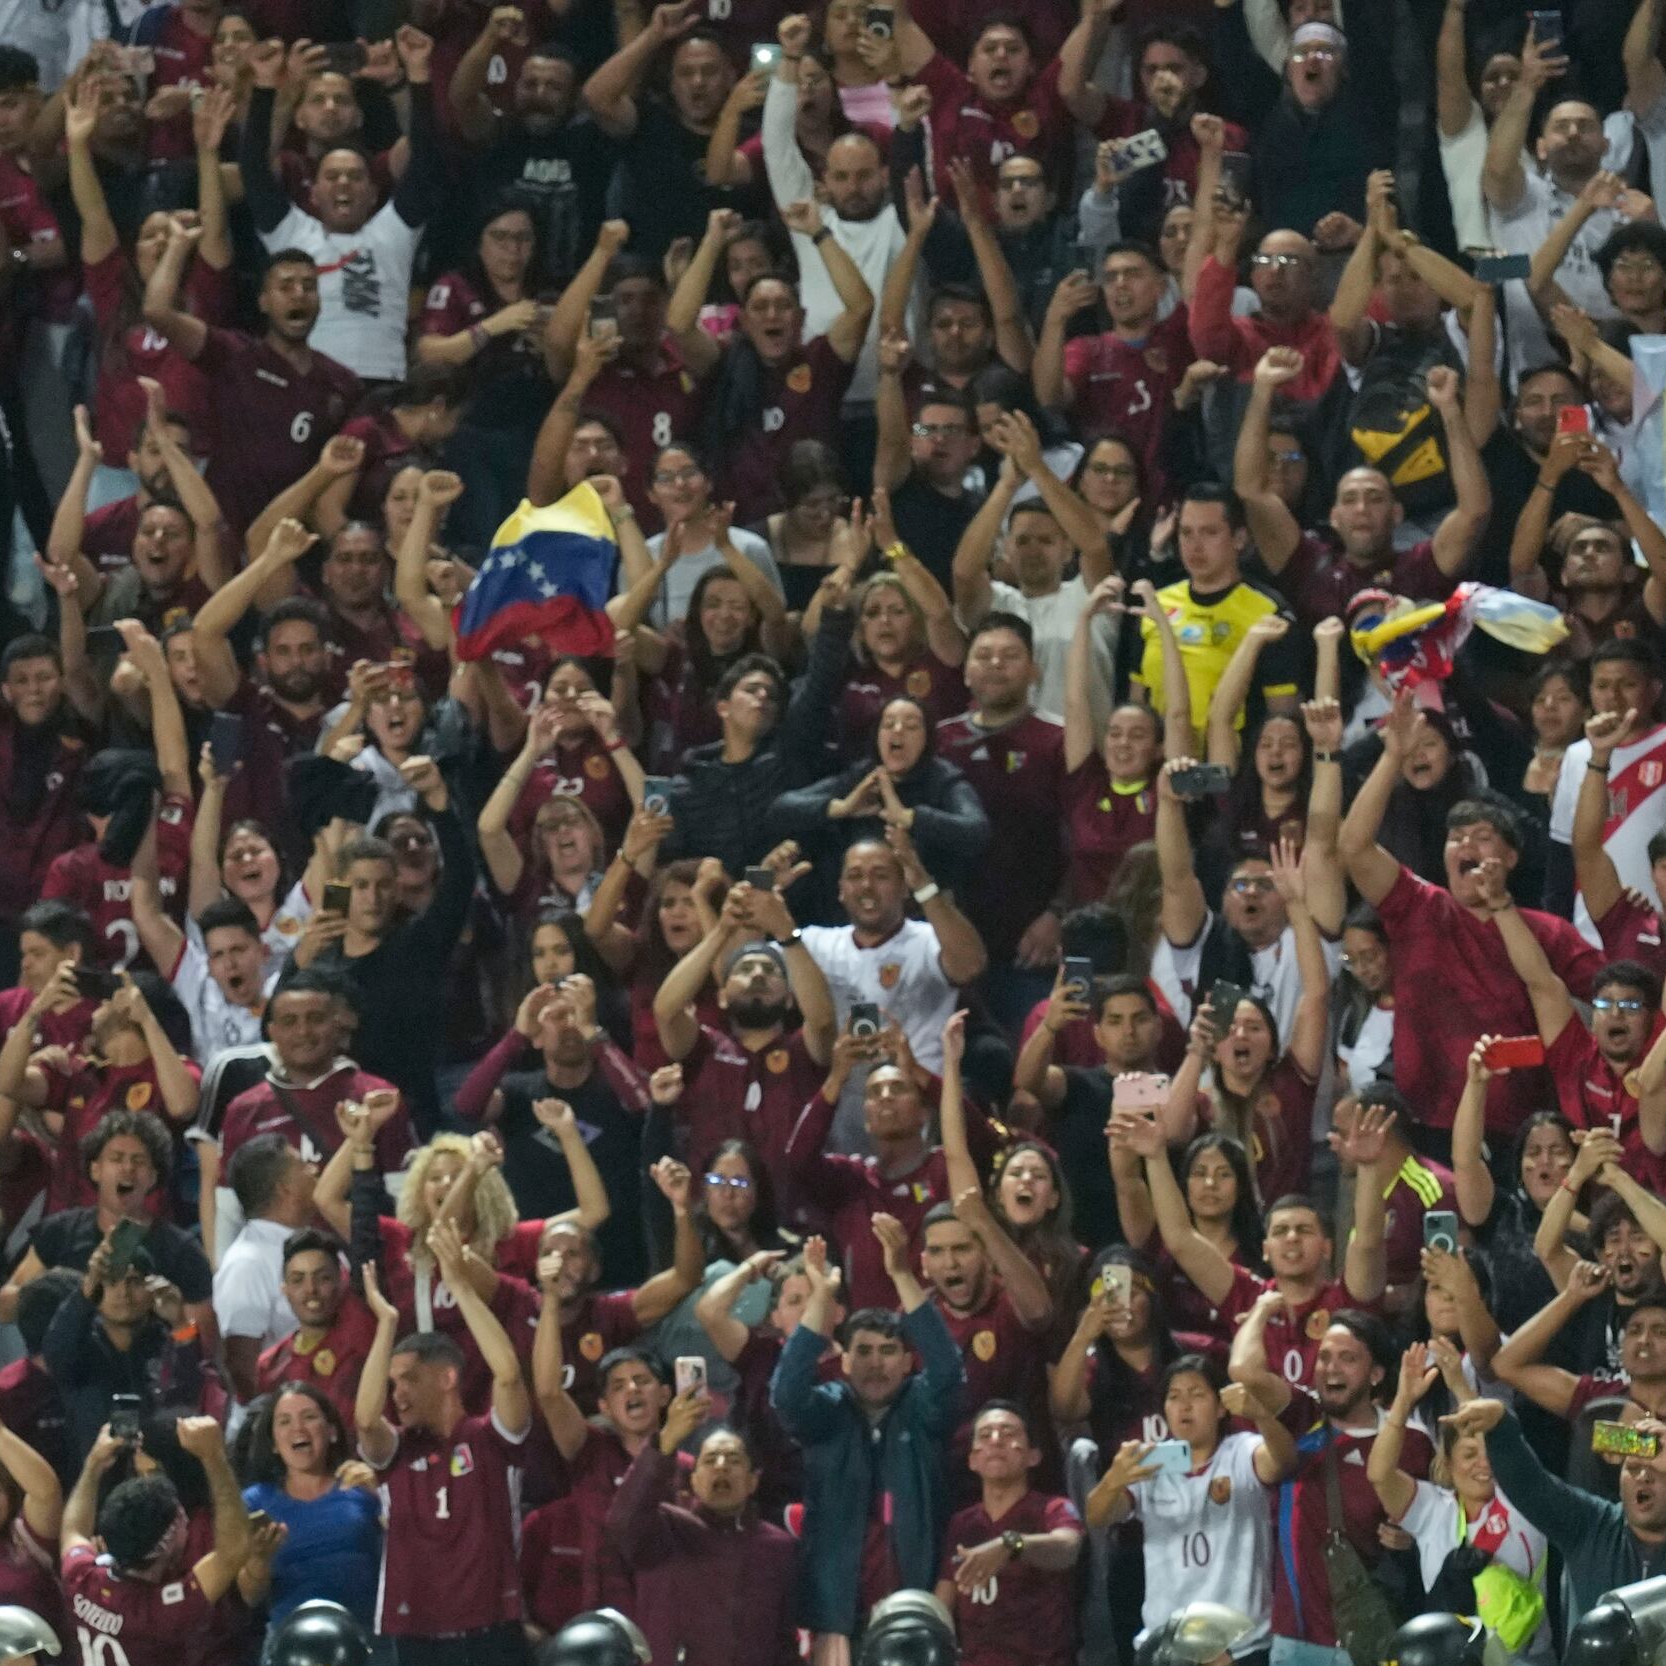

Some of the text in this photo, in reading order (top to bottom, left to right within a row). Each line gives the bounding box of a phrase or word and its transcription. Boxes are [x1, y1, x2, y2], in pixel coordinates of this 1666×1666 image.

[290, 411, 314, 443] 6
[652, 411, 672, 447] 8
[435, 1486, 451, 1520] 1
[1182, 1530, 1211, 1569] 10
